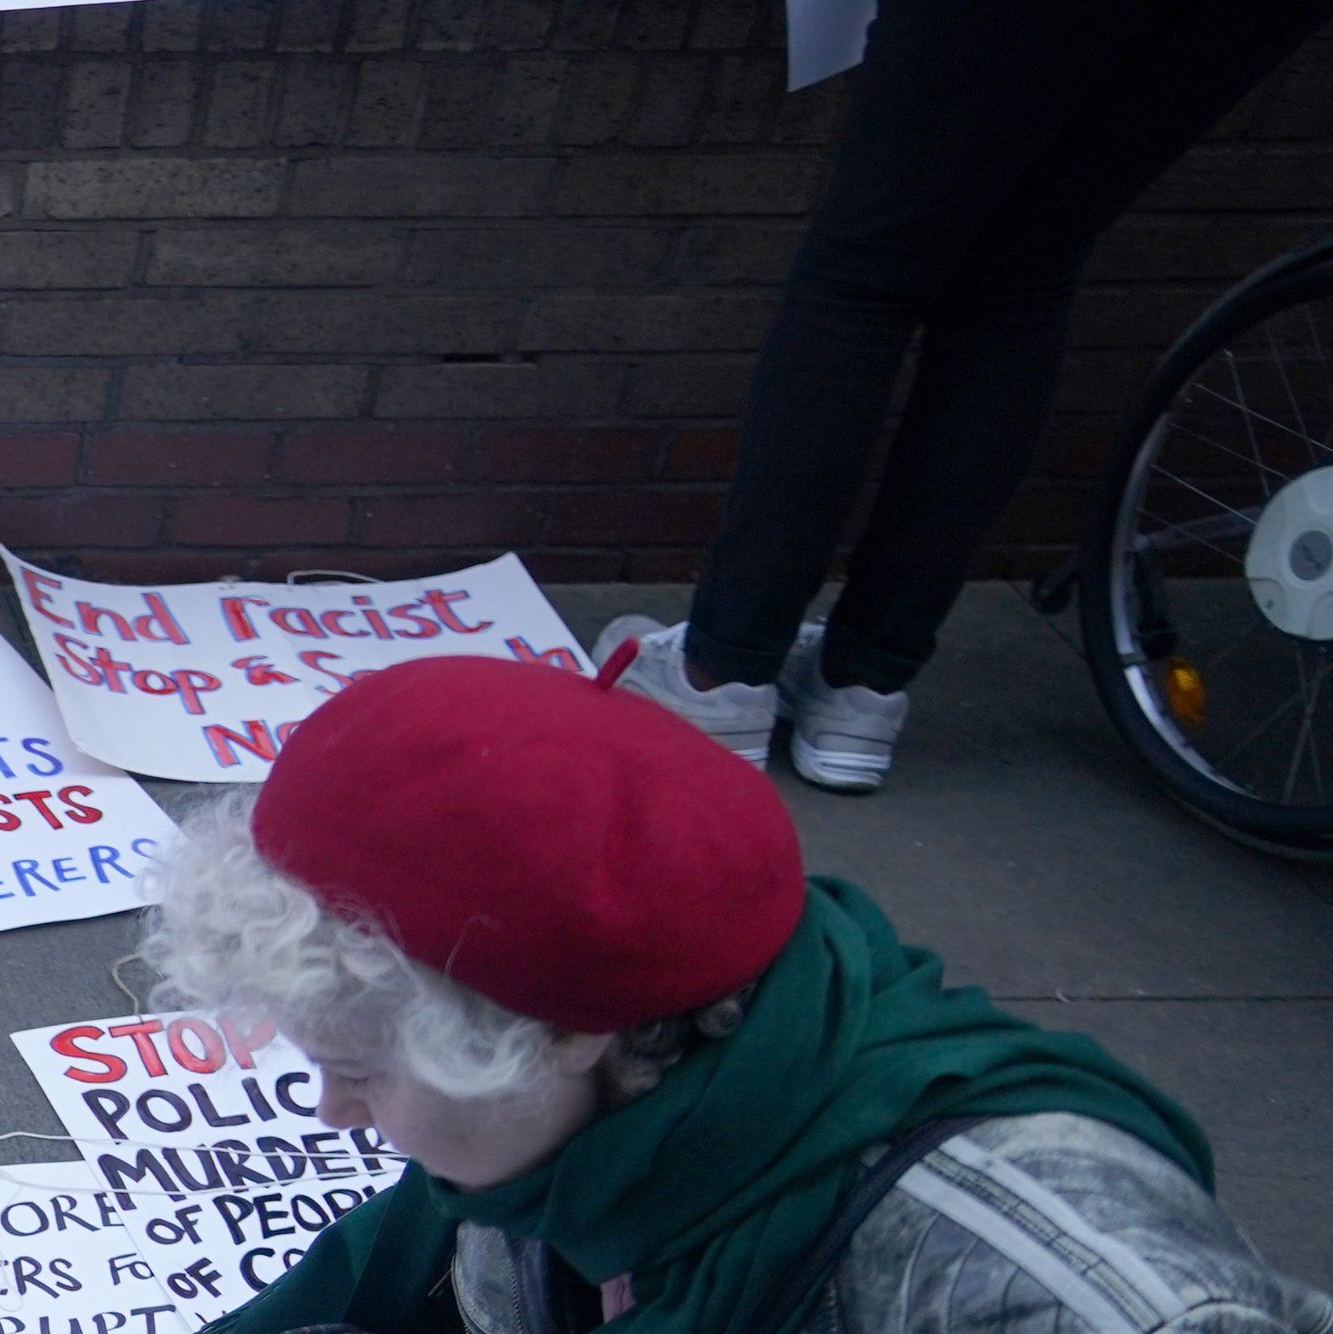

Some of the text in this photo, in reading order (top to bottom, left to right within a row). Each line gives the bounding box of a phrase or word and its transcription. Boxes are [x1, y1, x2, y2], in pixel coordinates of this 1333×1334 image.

[19, 565, 494, 645] End racist
[53, 632, 222, 715] Stop
[231, 654, 301, 686] &
[50, 1017, 277, 1084] STOP
[81, 1072, 321, 1144] POLIC
[146, 1204, 202, 1244] OF
[108, 1253, 154, 1286] FO
[167, 1257, 223, 1299] OF
